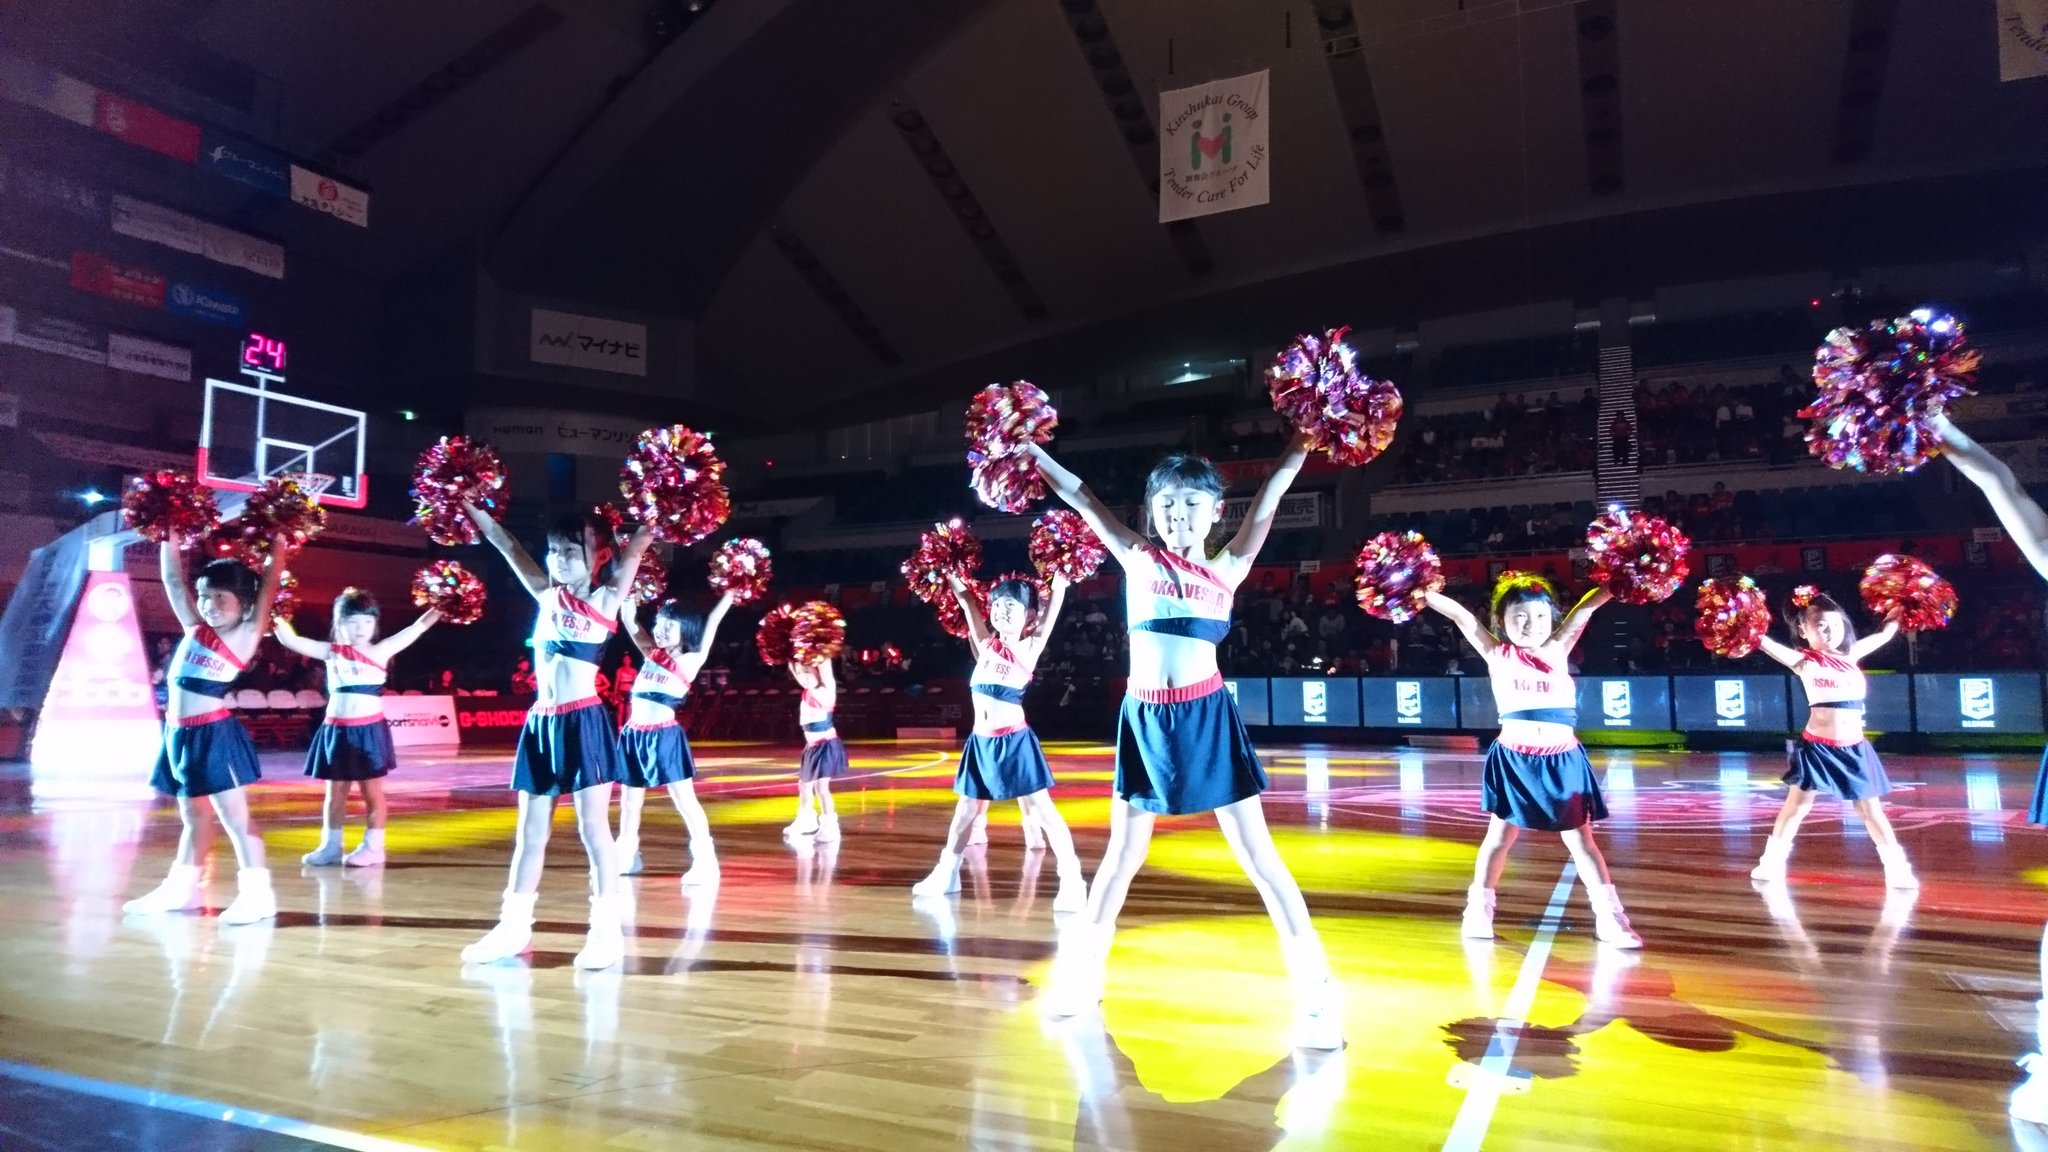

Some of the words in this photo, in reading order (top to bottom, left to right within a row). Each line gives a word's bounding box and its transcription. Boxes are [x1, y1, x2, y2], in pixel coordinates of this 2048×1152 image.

[1166, 94, 1224, 137] Kinshukai
[1226, 94, 1259, 121] Group
[1164, 168, 1195, 200] Tender
[1197, 189, 1227, 204] Care
[1229, 171, 1249, 194] For
[1247, 144, 1265, 171] Life
[245, 332, 285, 369] 24
[577, 335, 641, 359] マイナビ
[385, 715, 439, 728] portsnavi
